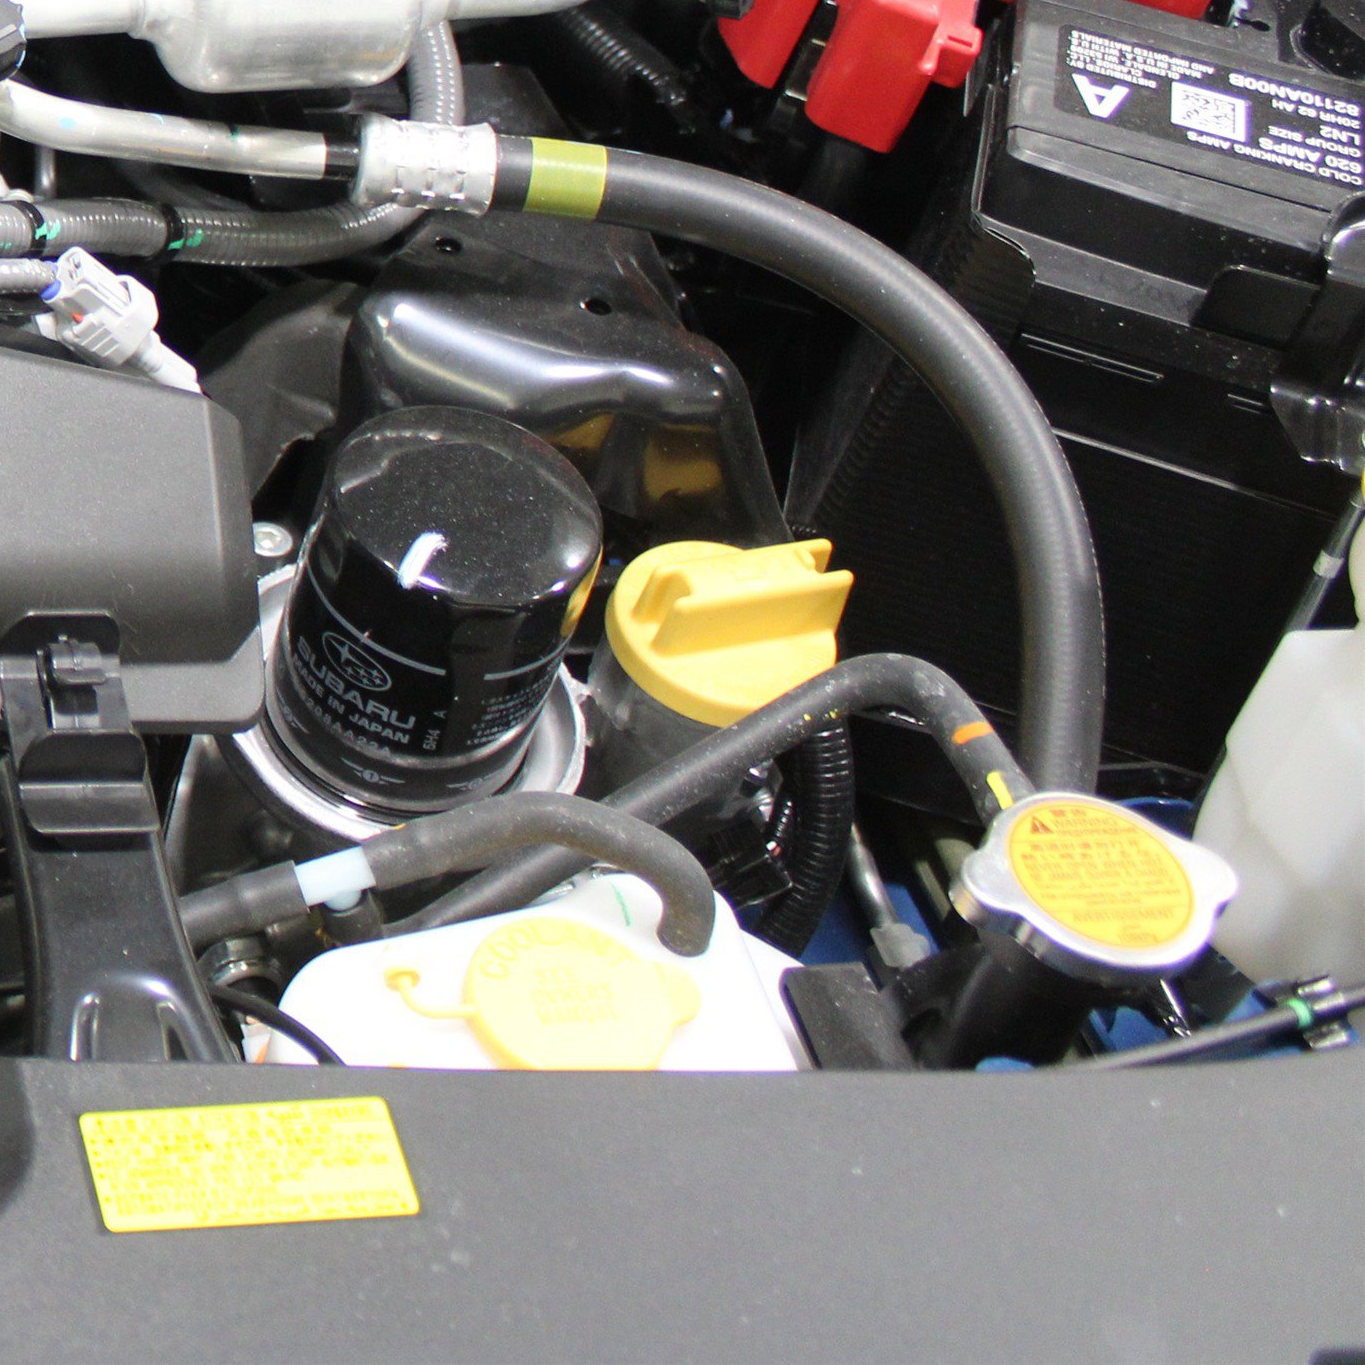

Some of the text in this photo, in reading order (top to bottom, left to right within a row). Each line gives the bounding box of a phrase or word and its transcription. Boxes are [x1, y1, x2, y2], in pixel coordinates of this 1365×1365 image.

[1070, 30, 1215, 75] AND IMPORTED MATERIALS
[1090, 43, 1120, 56] WITH
[1103, 54, 1119, 63] WI
[1156, 61, 1168, 69] IN
[1065, 57, 1157, 88] DISTRIBUTED BY:
[1169, 64, 1203, 79] MADE
[1072, 73, 1130, 119] A
[1229, 73, 1360, 117] 82110AN00B
[1271, 98, 1361, 130] 20HR 62 AH
[1268, 125, 1361, 158] GROUP SIZE
[1319, 125, 1360, 146] LN2
[1186, 131, 1362, 186] COLD CRANKING AMPS
[1258, 136, 1362, 174] 620 AMPS
[297, 636, 416, 730] SUBARU
[327, 697, 345, 715] IN
[349, 707, 411, 745] JAPAN
